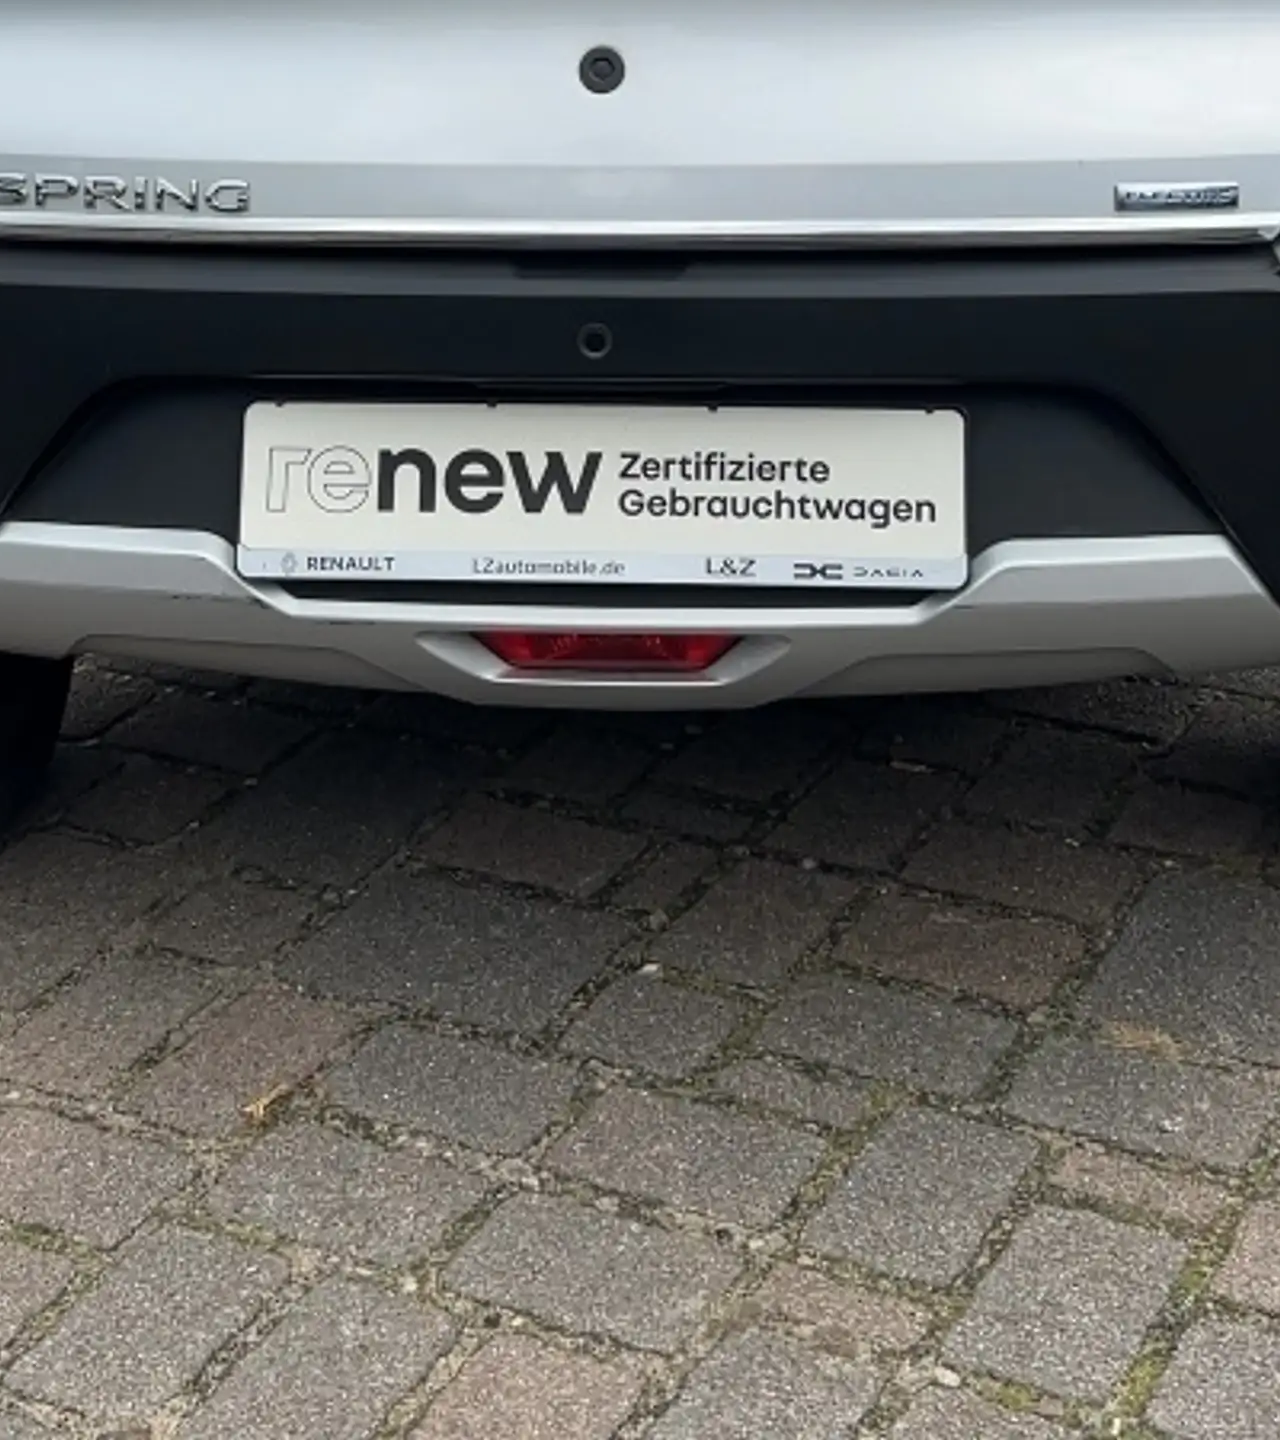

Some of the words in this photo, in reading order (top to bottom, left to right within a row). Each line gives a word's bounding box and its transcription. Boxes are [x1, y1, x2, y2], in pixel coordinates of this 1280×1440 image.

[266, 445, 603, 514] renew
[618, 451, 831, 483] Zertifizierte
[618, 488, 936, 528] Gebrauchtwagen
[306, 556, 395, 572] RENAULT
[472, 557, 625, 576] LZautomobile.de
[705, 557, 756, 577] L&Z
